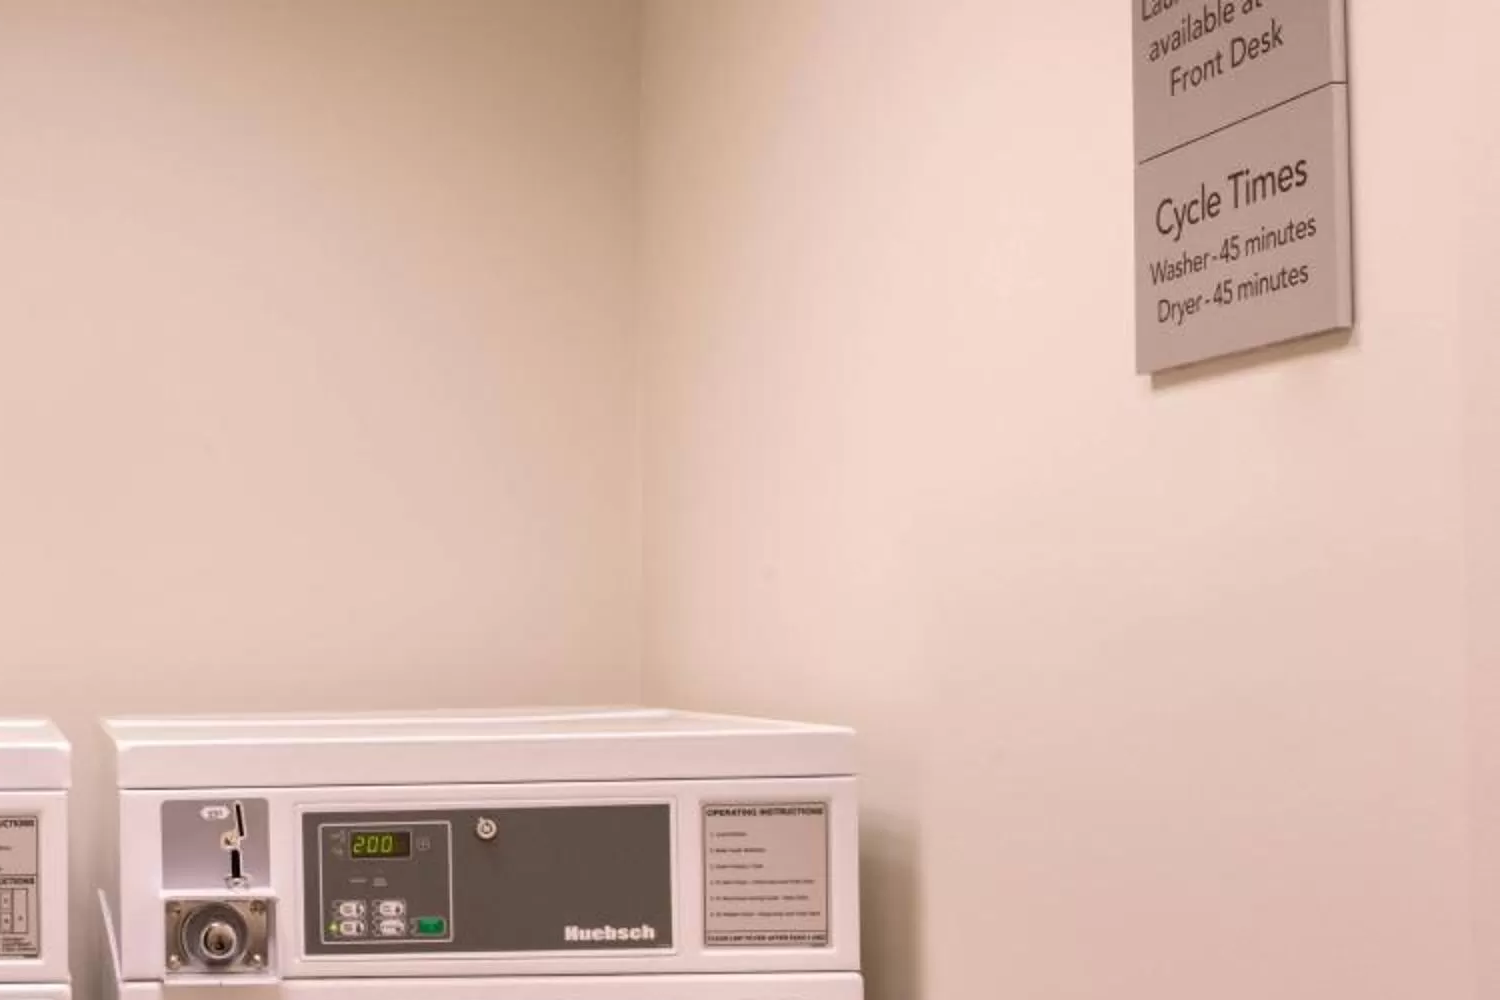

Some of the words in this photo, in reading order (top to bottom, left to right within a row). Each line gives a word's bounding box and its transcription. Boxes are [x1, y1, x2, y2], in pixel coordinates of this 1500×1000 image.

[1141, 0, 1179, 21] Lau
[1149, 0, 1235, 62] available
[1170, 50, 1224, 97] Front
[1231, 18, 1284, 68] Desk
[1155, 183, 1221, 242] Cycle
[1228, 159, 1308, 209] Times
[1245, 216, 1317, 257] minutes
[1237, 264, 1309, 301] minutes
[353, 835, 393, 853] 200
[564, 924, 655, 941] Huebsch
